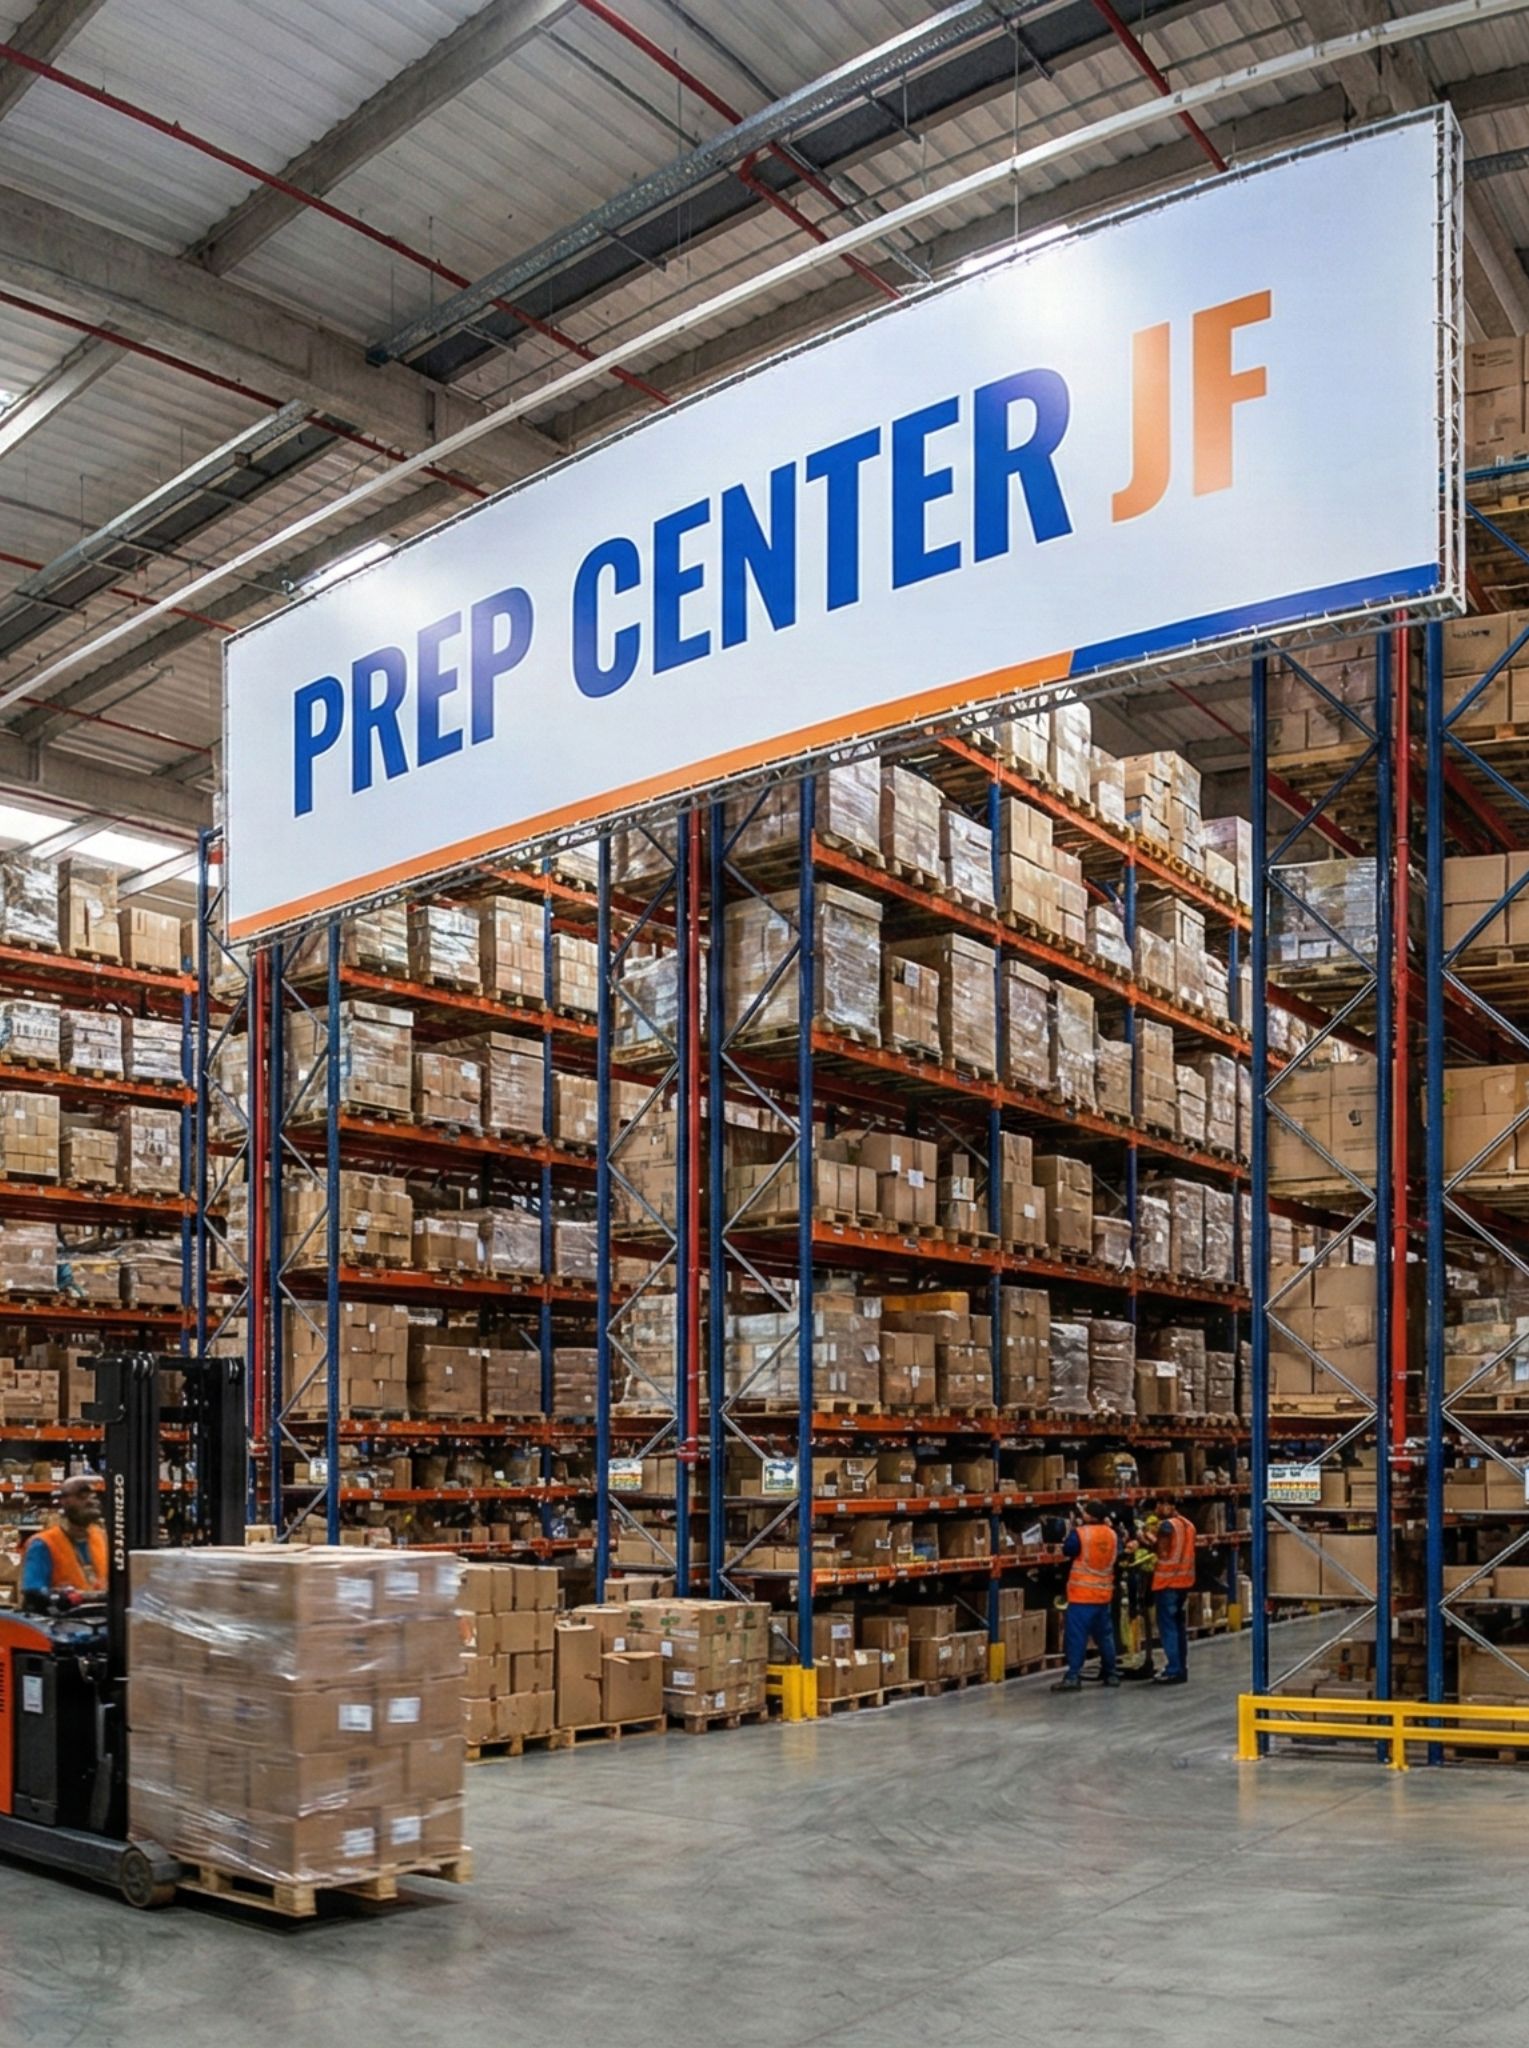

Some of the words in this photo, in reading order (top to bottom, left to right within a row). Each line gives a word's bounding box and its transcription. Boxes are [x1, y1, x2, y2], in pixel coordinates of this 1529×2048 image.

[293, 587, 533, 818] PREP
[573, 368, 1073, 698] CENTER
[1111, 290, 1273, 524] JF
